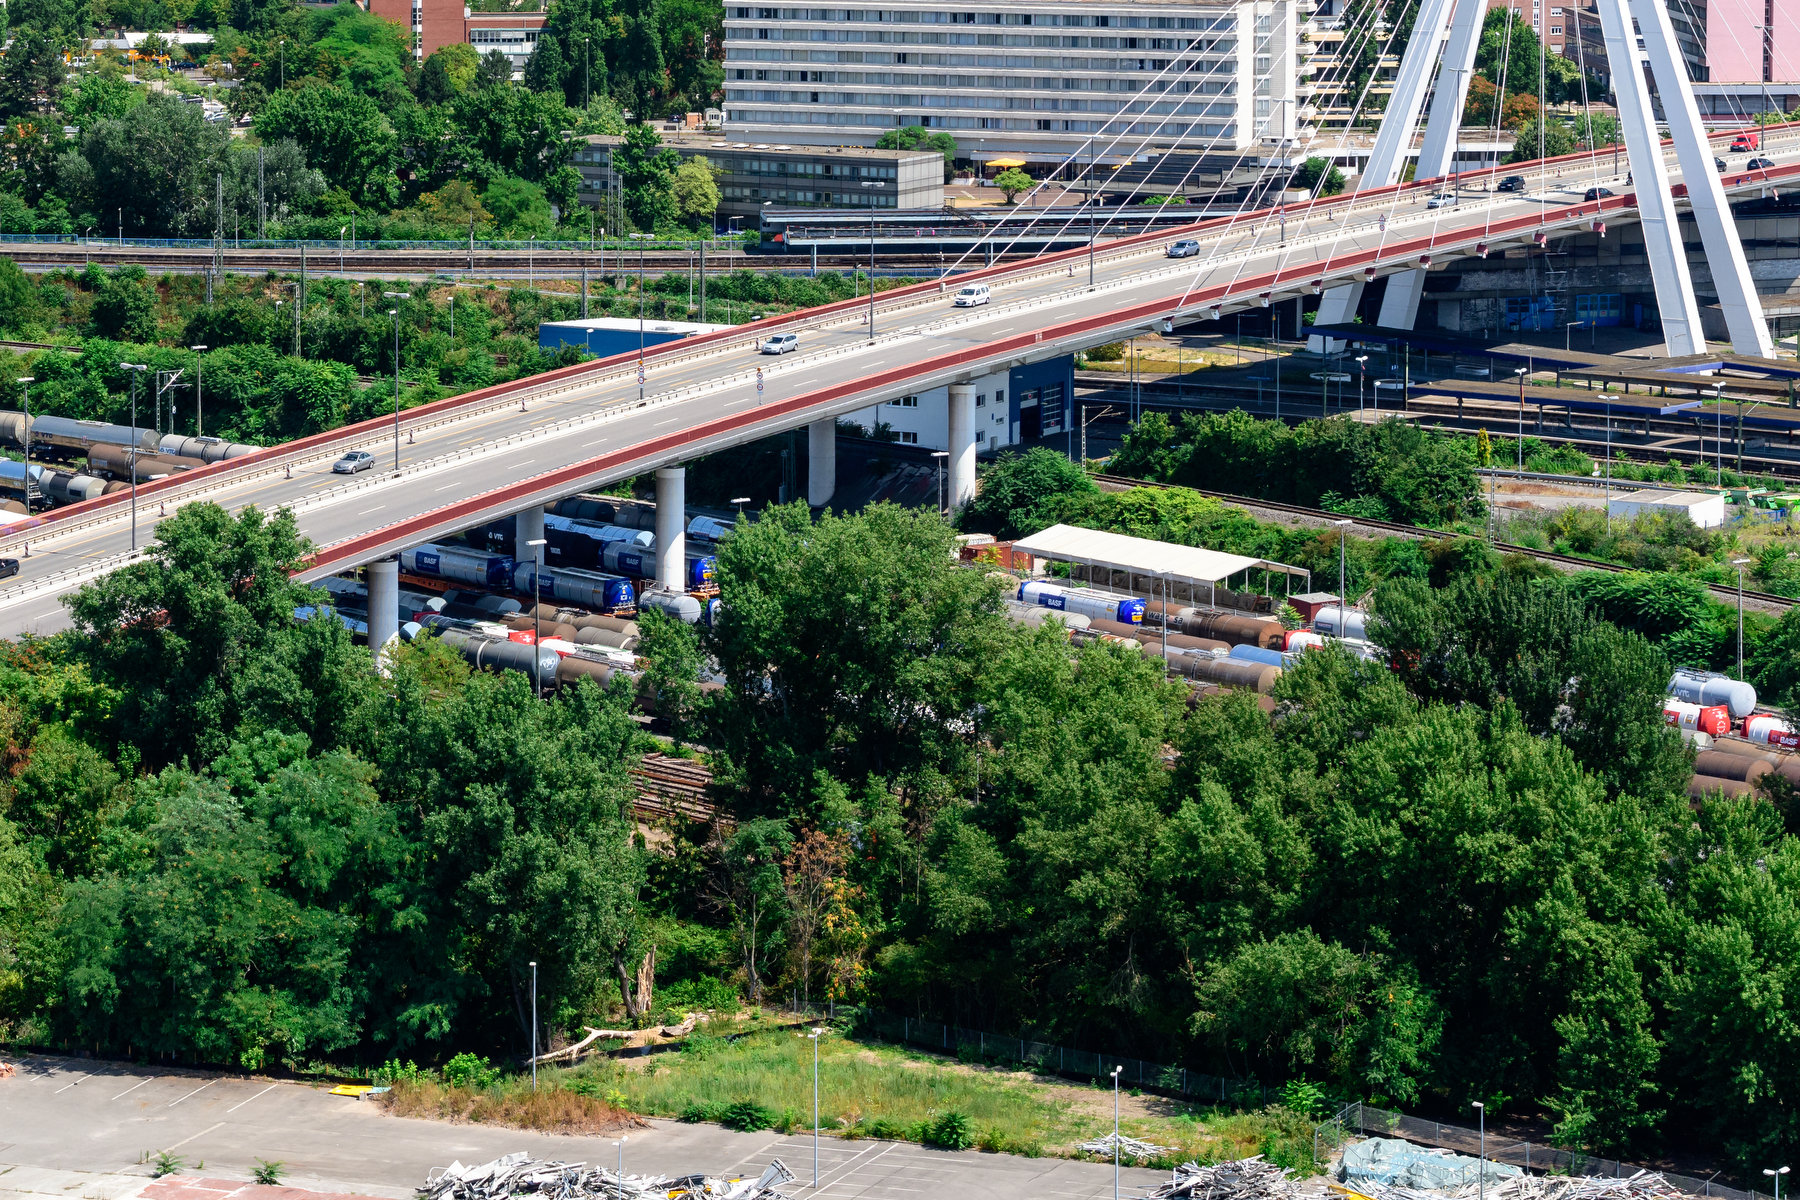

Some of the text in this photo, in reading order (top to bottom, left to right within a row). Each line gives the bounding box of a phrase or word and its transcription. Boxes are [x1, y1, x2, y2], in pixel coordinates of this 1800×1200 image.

[493, 532, 504, 541] VTG
[423, 556, 437, 565] BASF
[1047, 597, 1063, 608] BASF
[1779, 735, 1799, 746] BASF
